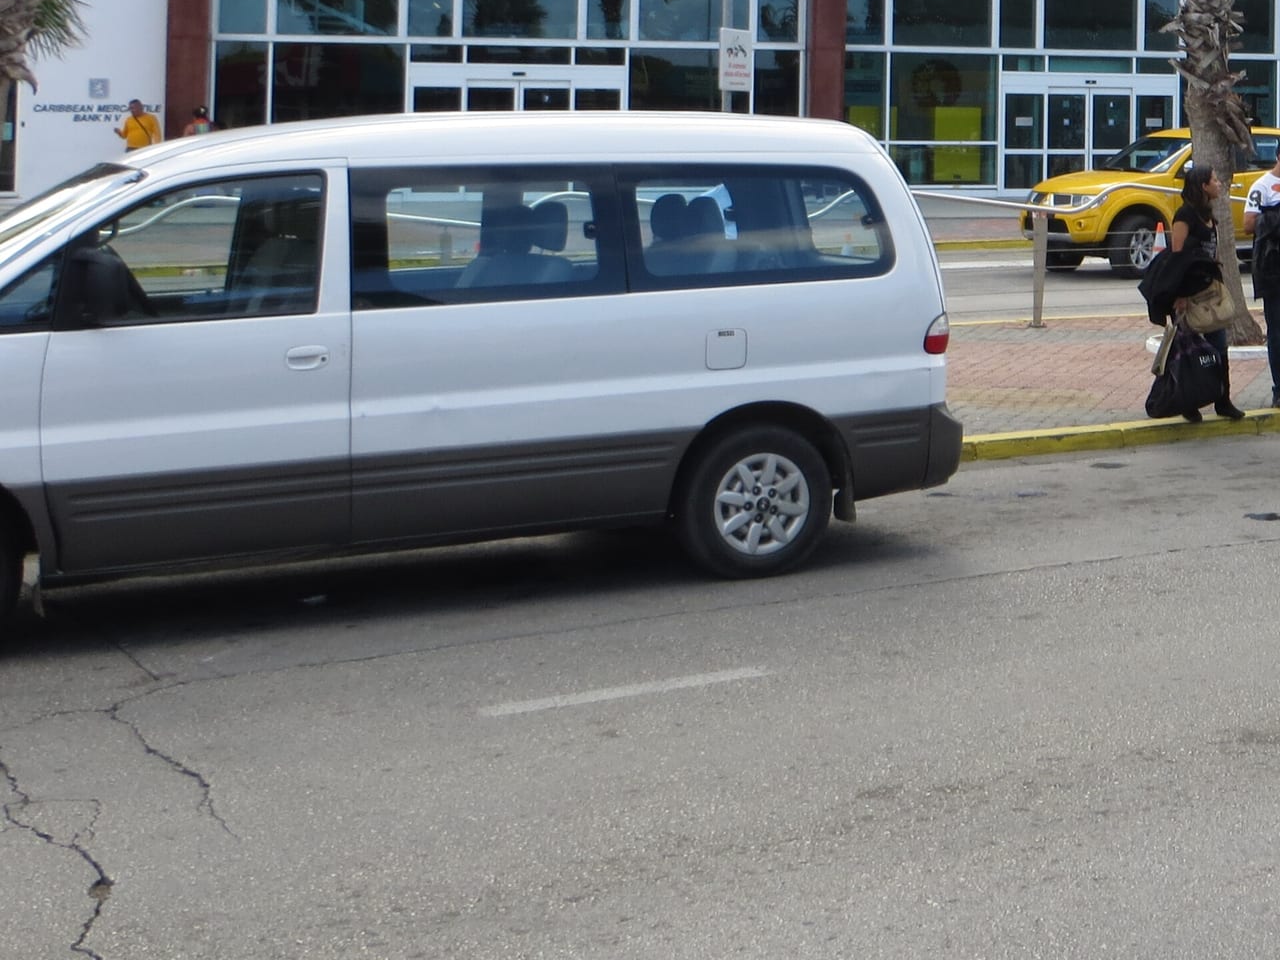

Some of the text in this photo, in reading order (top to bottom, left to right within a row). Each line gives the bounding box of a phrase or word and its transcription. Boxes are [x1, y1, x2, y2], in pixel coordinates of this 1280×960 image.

[33, 104, 162, 113] CARIBBEAN MERCATILE
[73, 113, 102, 122] BANK
